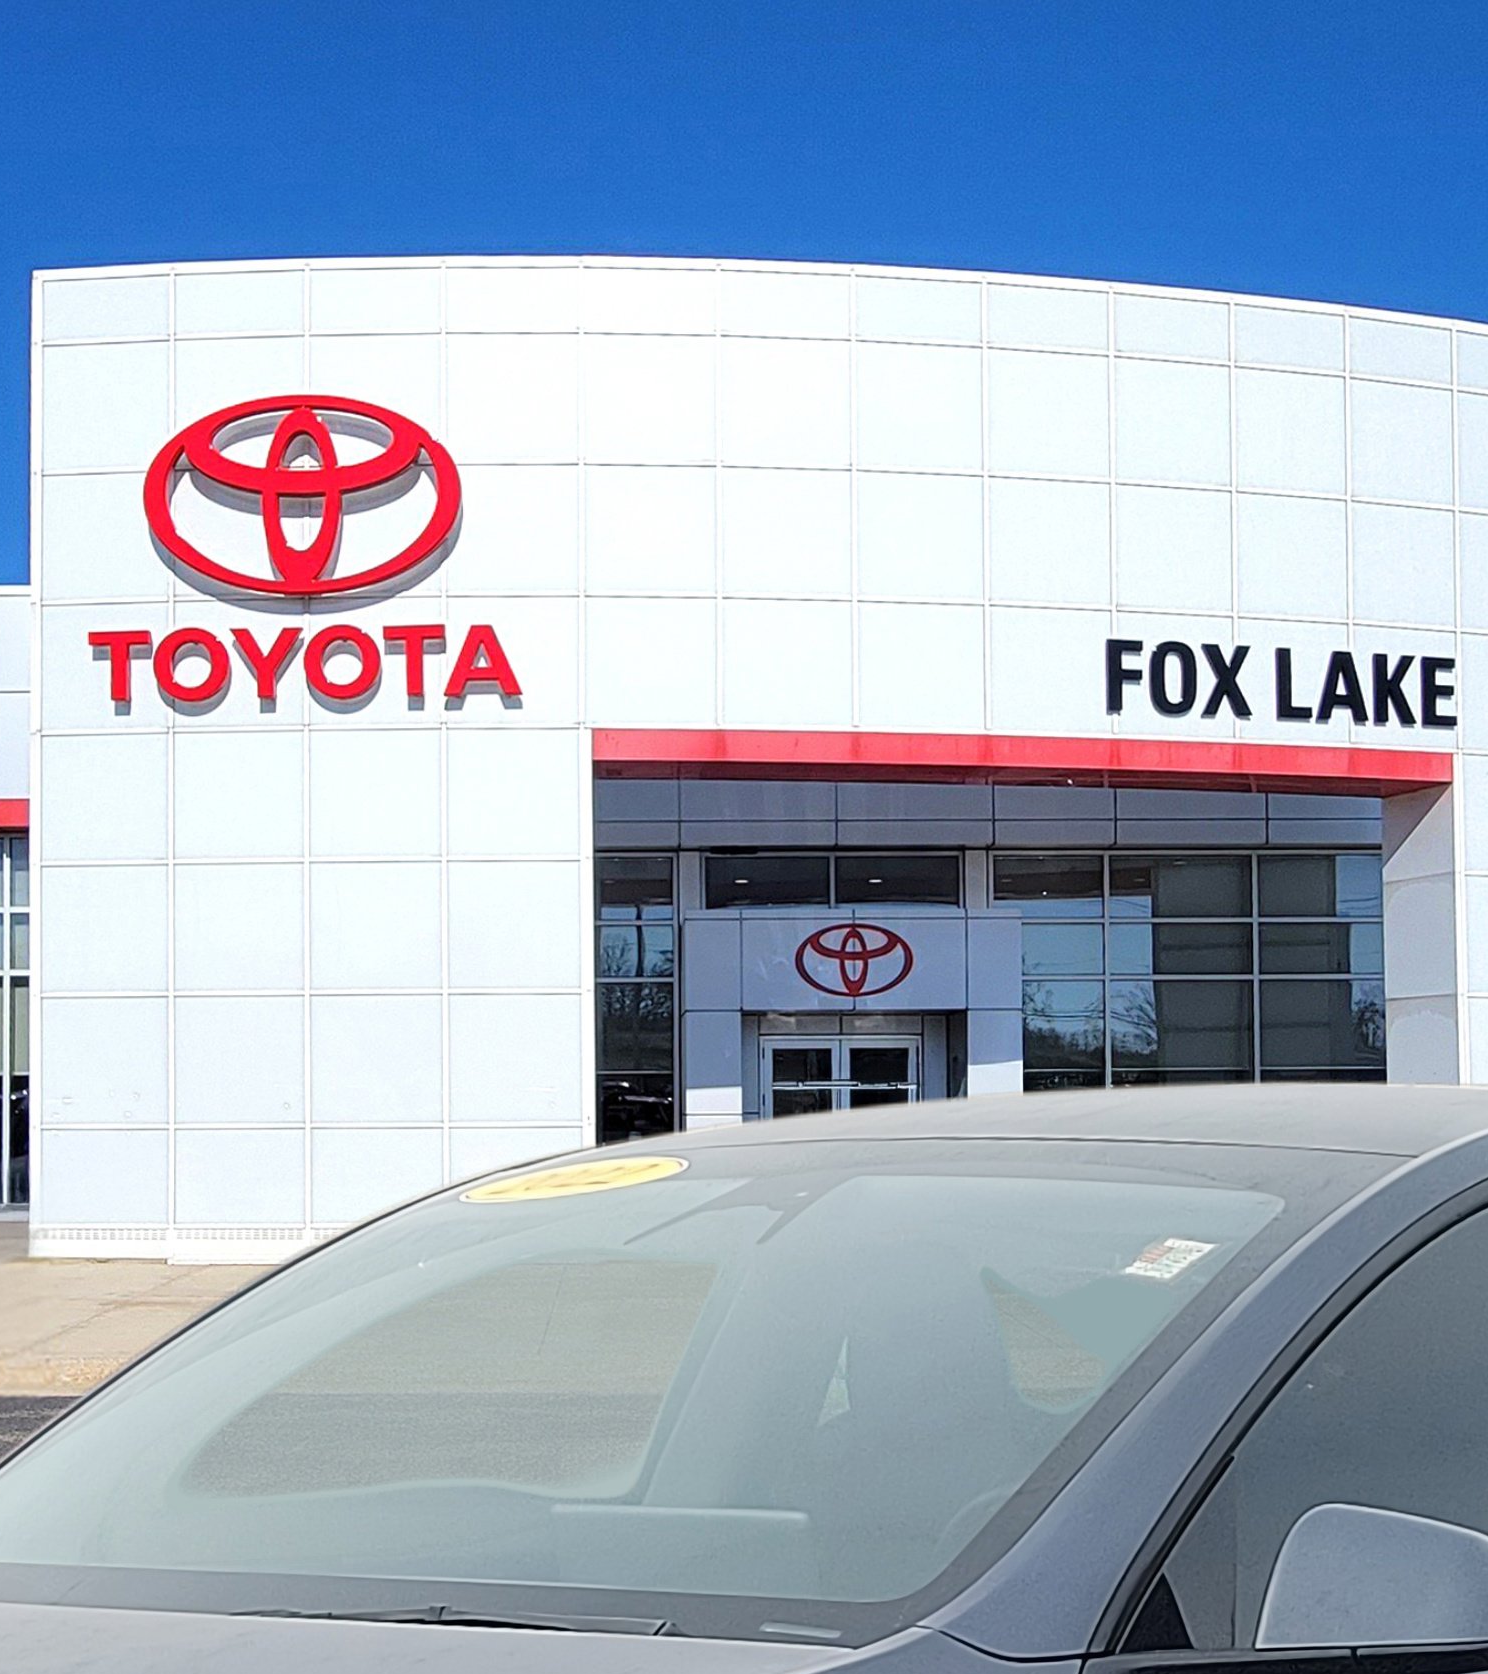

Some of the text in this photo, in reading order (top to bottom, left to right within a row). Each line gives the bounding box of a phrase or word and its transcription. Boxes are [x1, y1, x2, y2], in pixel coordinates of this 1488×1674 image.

[88, 624, 523, 707] TOYOTA
[1105, 638, 1458, 728] FOX LAKE
